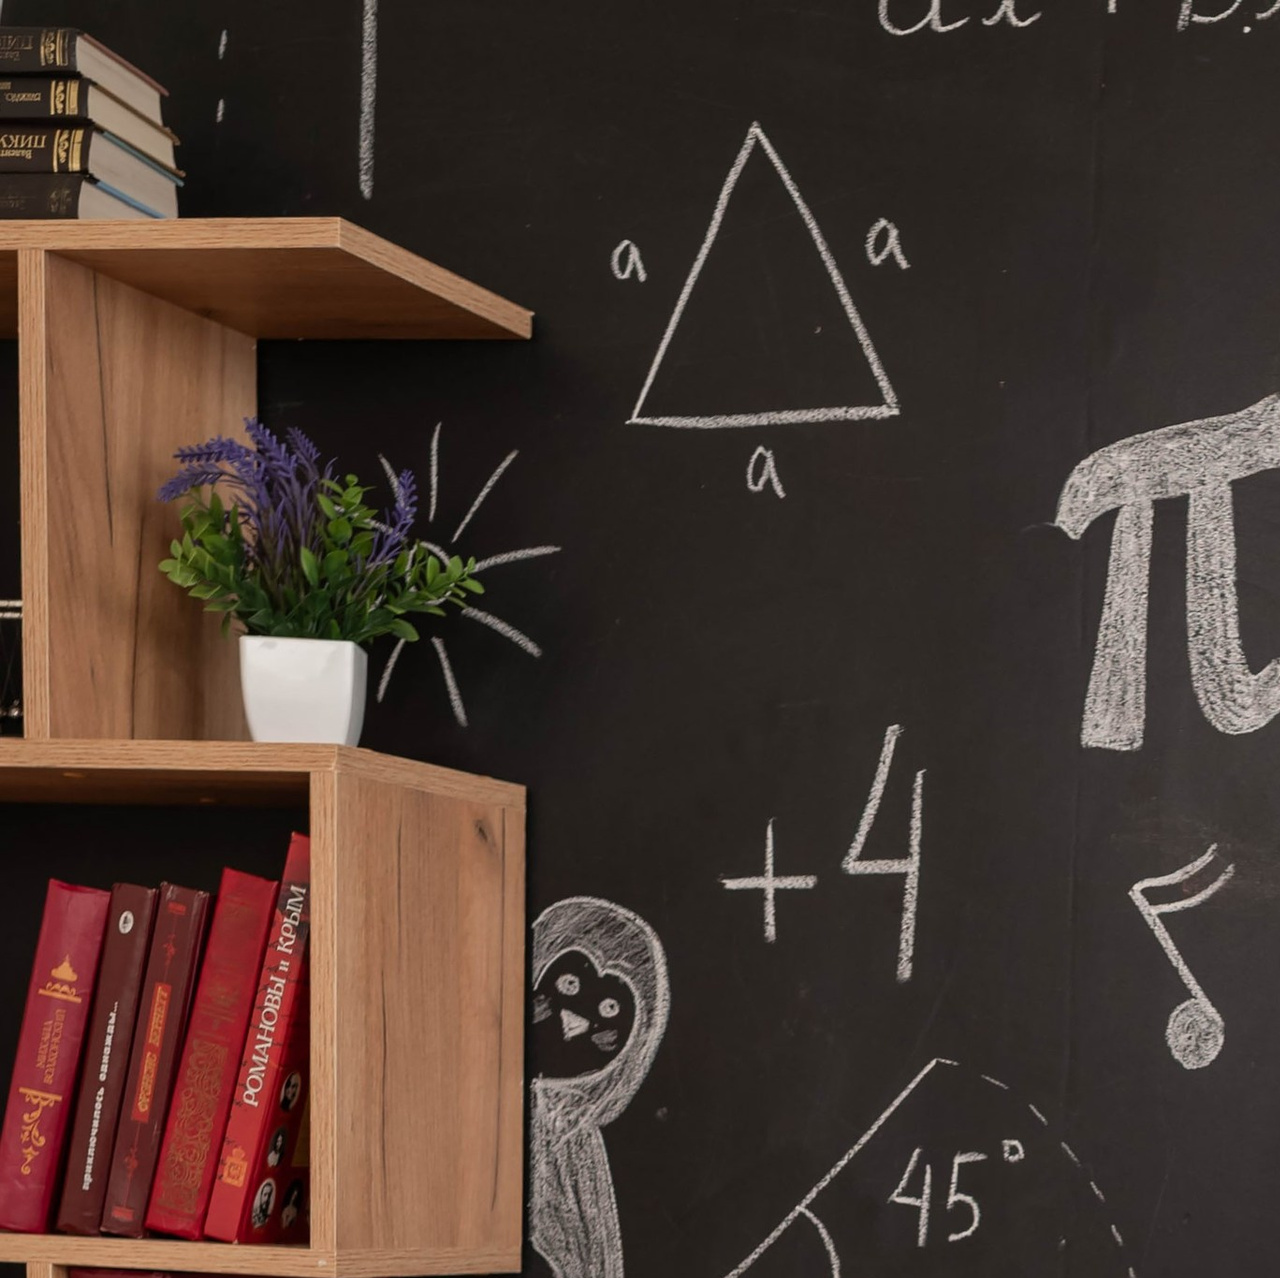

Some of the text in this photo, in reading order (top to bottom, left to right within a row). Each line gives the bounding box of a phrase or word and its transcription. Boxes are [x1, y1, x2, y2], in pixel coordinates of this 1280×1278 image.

[612, 240, 646, 281] a
[865, 218, 910, 269] a
[747, 446, 785, 498] a
[243, 975, 286, 1107] РОМАНОВЫ
[277, 885, 306, 954] КРЫМ
